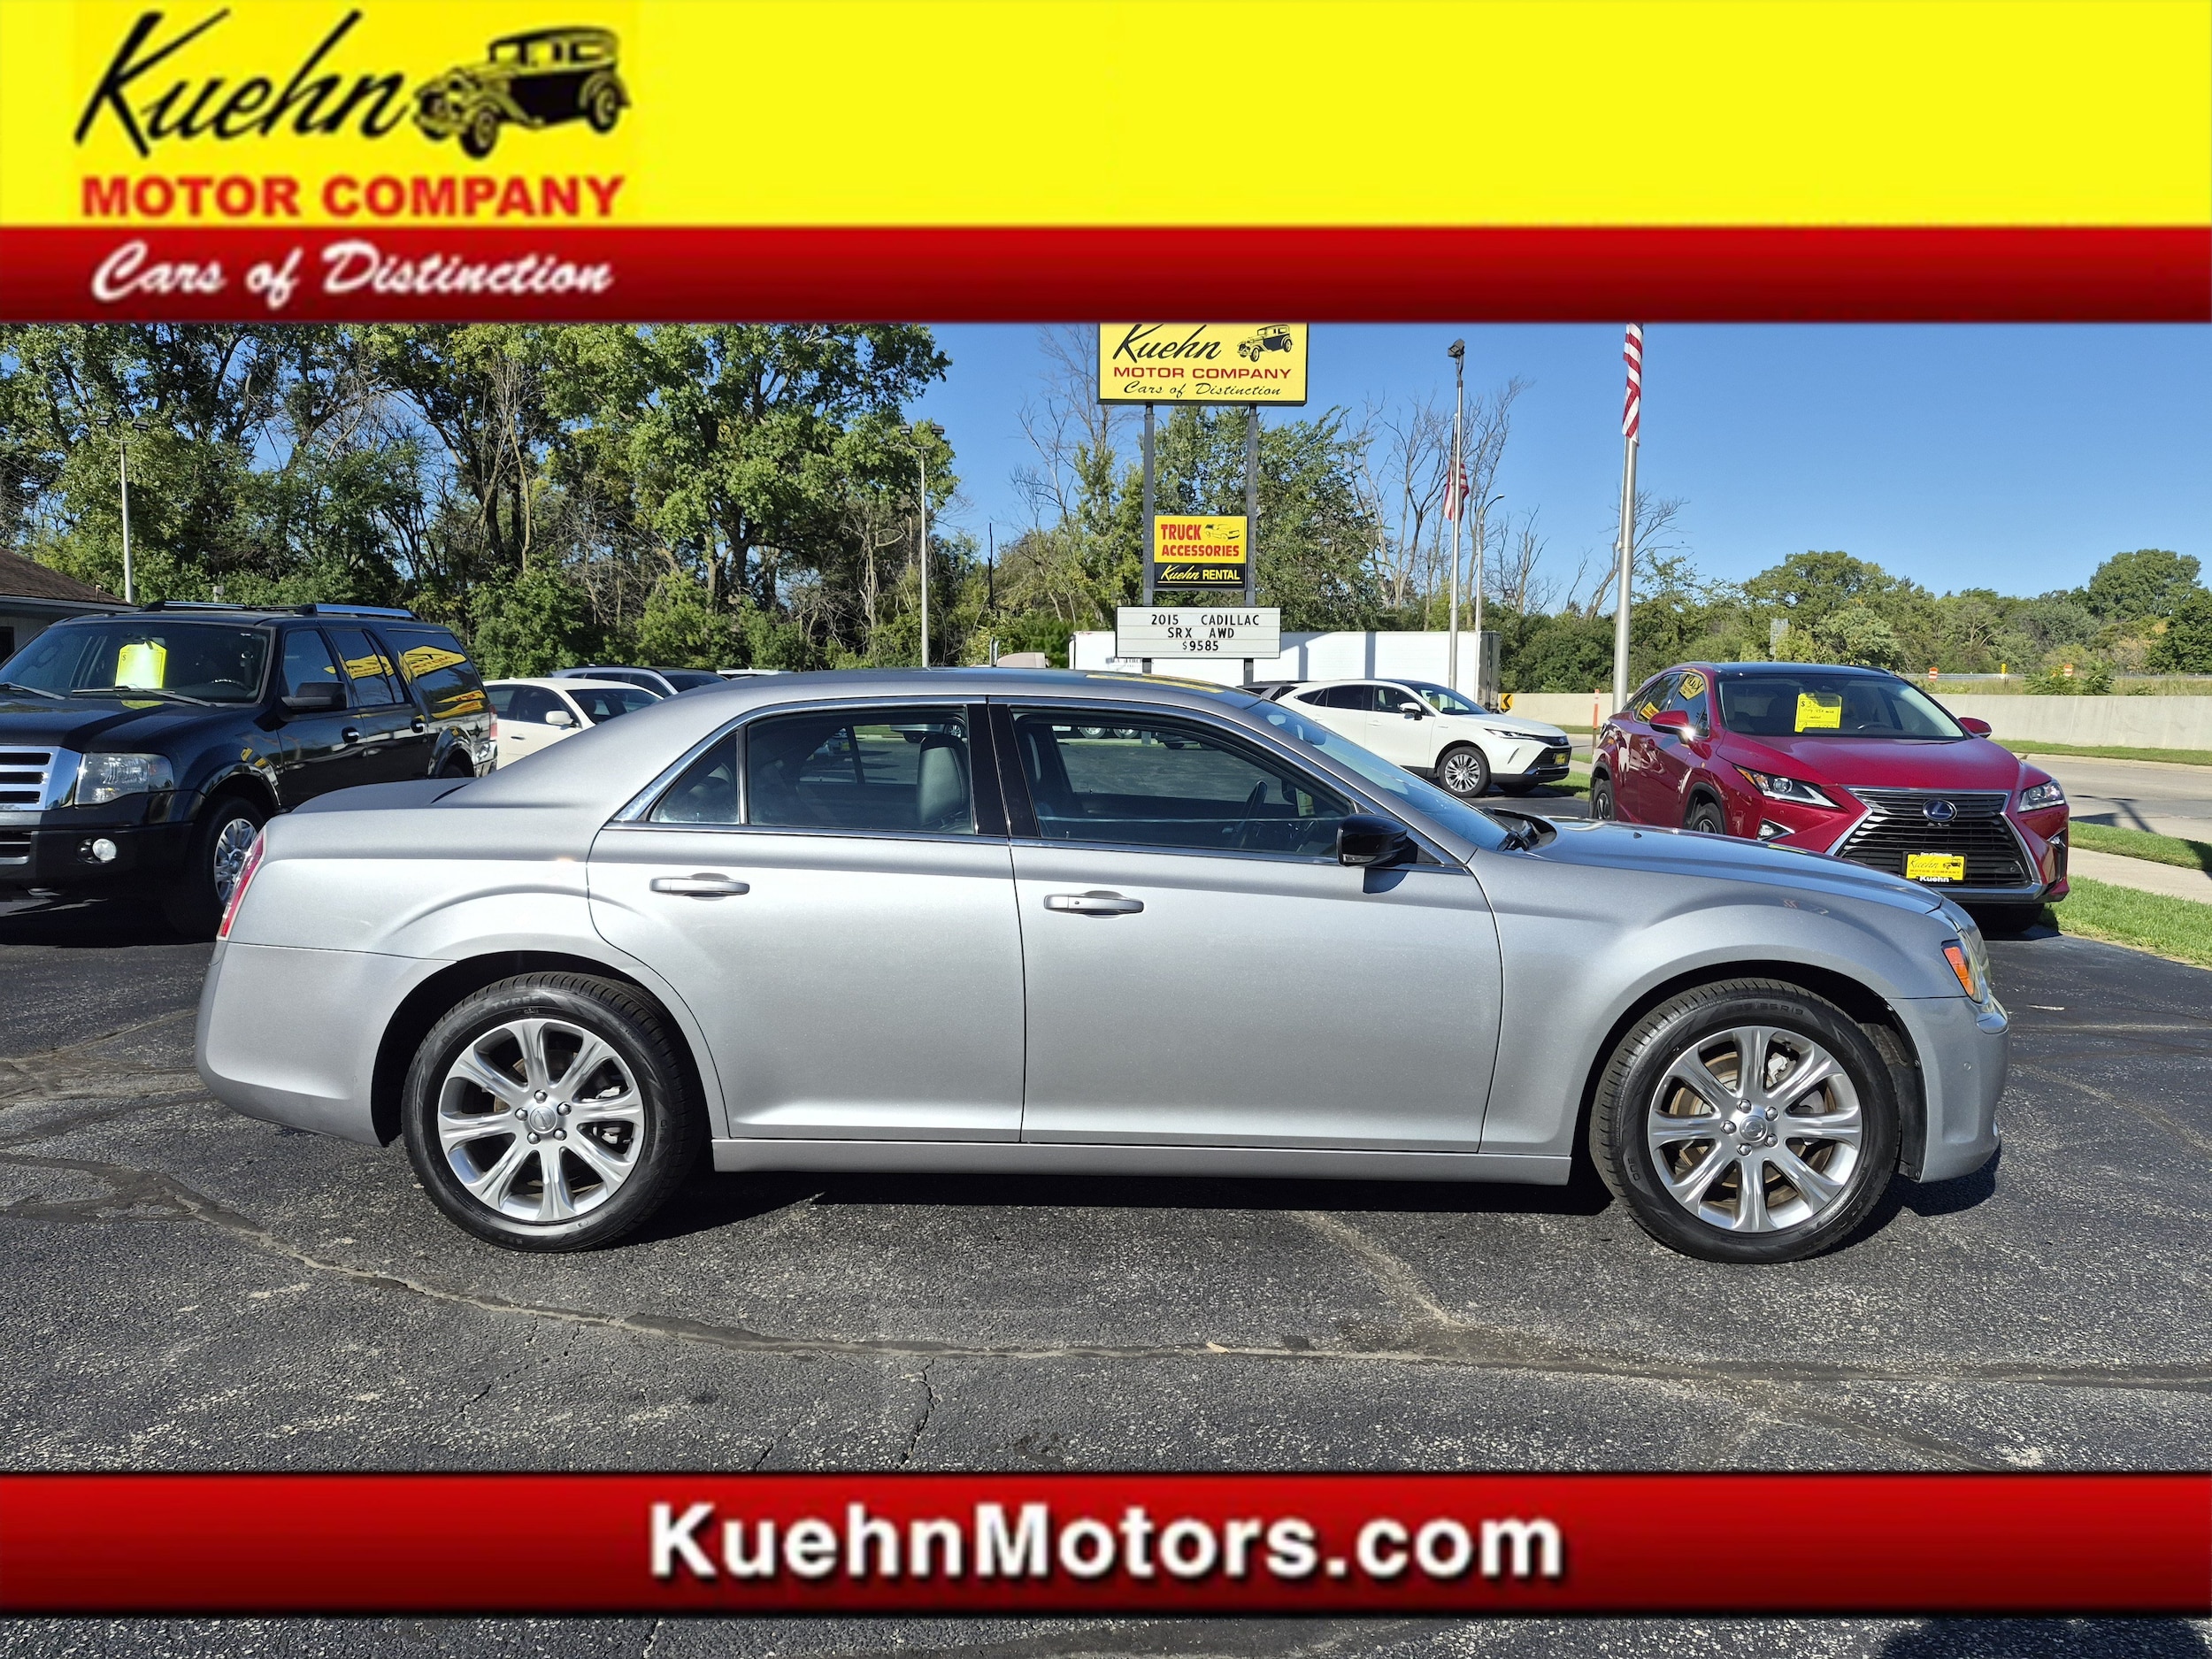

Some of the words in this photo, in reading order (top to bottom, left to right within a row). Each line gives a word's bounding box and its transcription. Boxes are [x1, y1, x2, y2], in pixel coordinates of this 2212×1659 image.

[1112, 324, 1222, 364] Kuehn
[1113, 366, 1185, 379] MOTOR
[1192, 367, 1292, 380] COMPANY
[1123, 380, 1163, 394] Cars
[1169, 383, 1187, 398] of
[1194, 382, 1282, 396] Distinction
[1160, 524, 1202, 541] TRUCK
[1161, 544, 1240, 557] ACCESSORIES
[1160, 565, 1200, 581] Kuehn
[1202, 569, 1240, 580] RENTAL
[1151, 614, 1179, 626] 2015
[1200, 614, 1260, 626] CADILLAC
[1167, 626, 1193, 639] SRX
[1209, 627, 1235, 639] AWD
[1182, 640, 1219, 651] $9585
